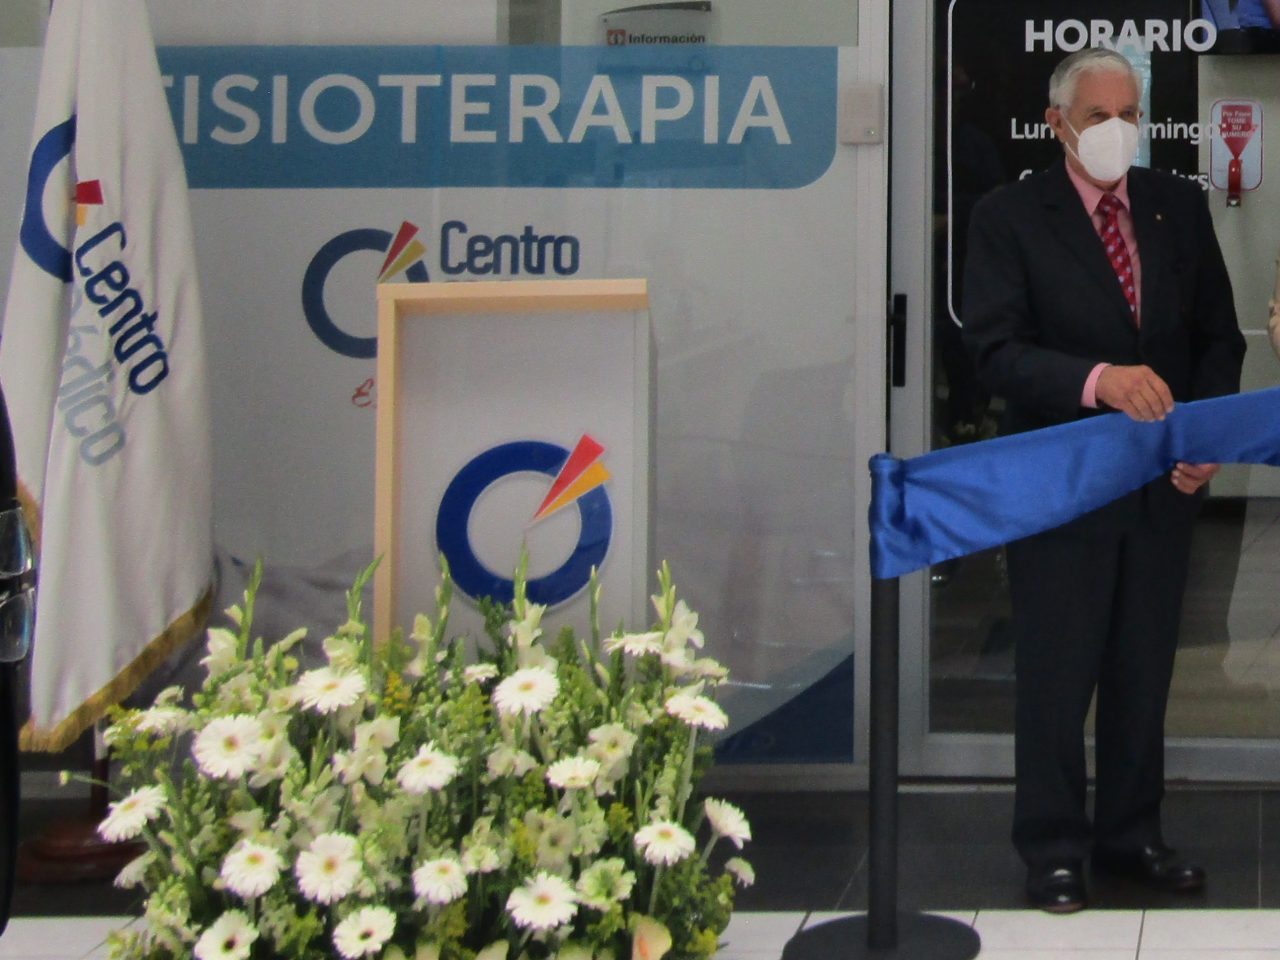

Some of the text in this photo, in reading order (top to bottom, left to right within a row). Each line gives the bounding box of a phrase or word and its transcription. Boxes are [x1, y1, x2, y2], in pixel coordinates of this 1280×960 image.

[628, 33, 706, 45] Información
[1024, 18, 1217, 53] HORARIO
[161, 73, 792, 145] ISIOTERAPIA
[440, 220, 580, 276] Centro
[75, 221, 169, 395] Centro
